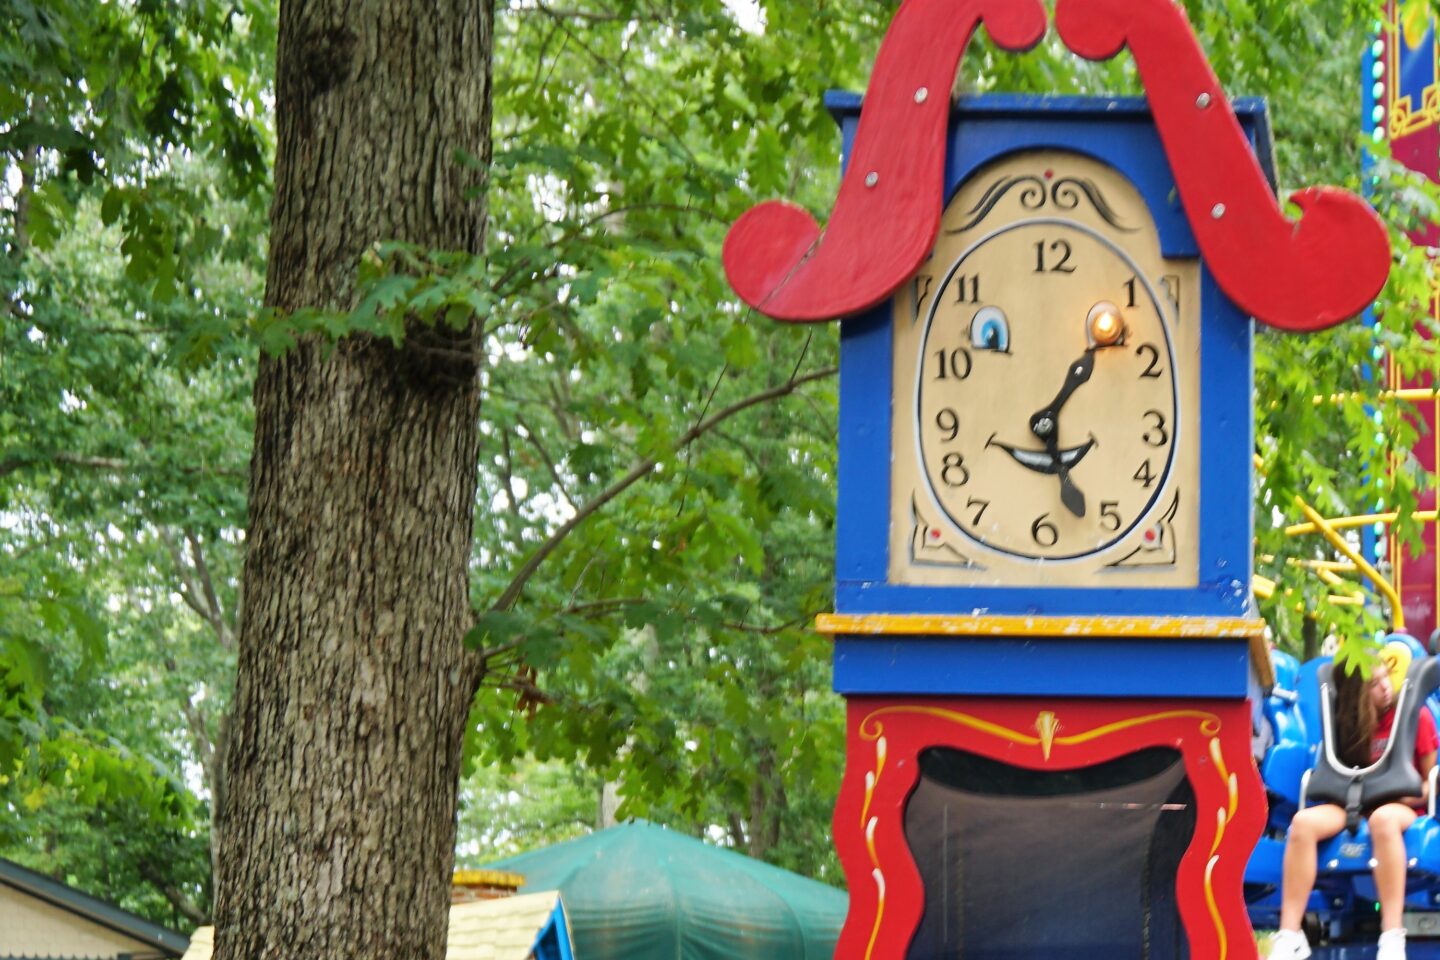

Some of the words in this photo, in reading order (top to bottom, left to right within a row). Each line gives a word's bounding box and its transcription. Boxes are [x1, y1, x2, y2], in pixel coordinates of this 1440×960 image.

[1032, 239, 1077, 274] 12
[953, 273, 980, 303] 11
[1122, 277, 1140, 308] 1
[933, 348, 973, 380] 10
[1135, 343, 1163, 379] 2
[936, 408, 959, 442] 9
[1142, 410, 1168, 447] 3
[941, 452, 969, 487] 8
[1133, 459, 1157, 487] 4
[966, 500, 989, 527] 7
[1031, 513, 1058, 547] 6
[1100, 501, 1121, 532] 5
